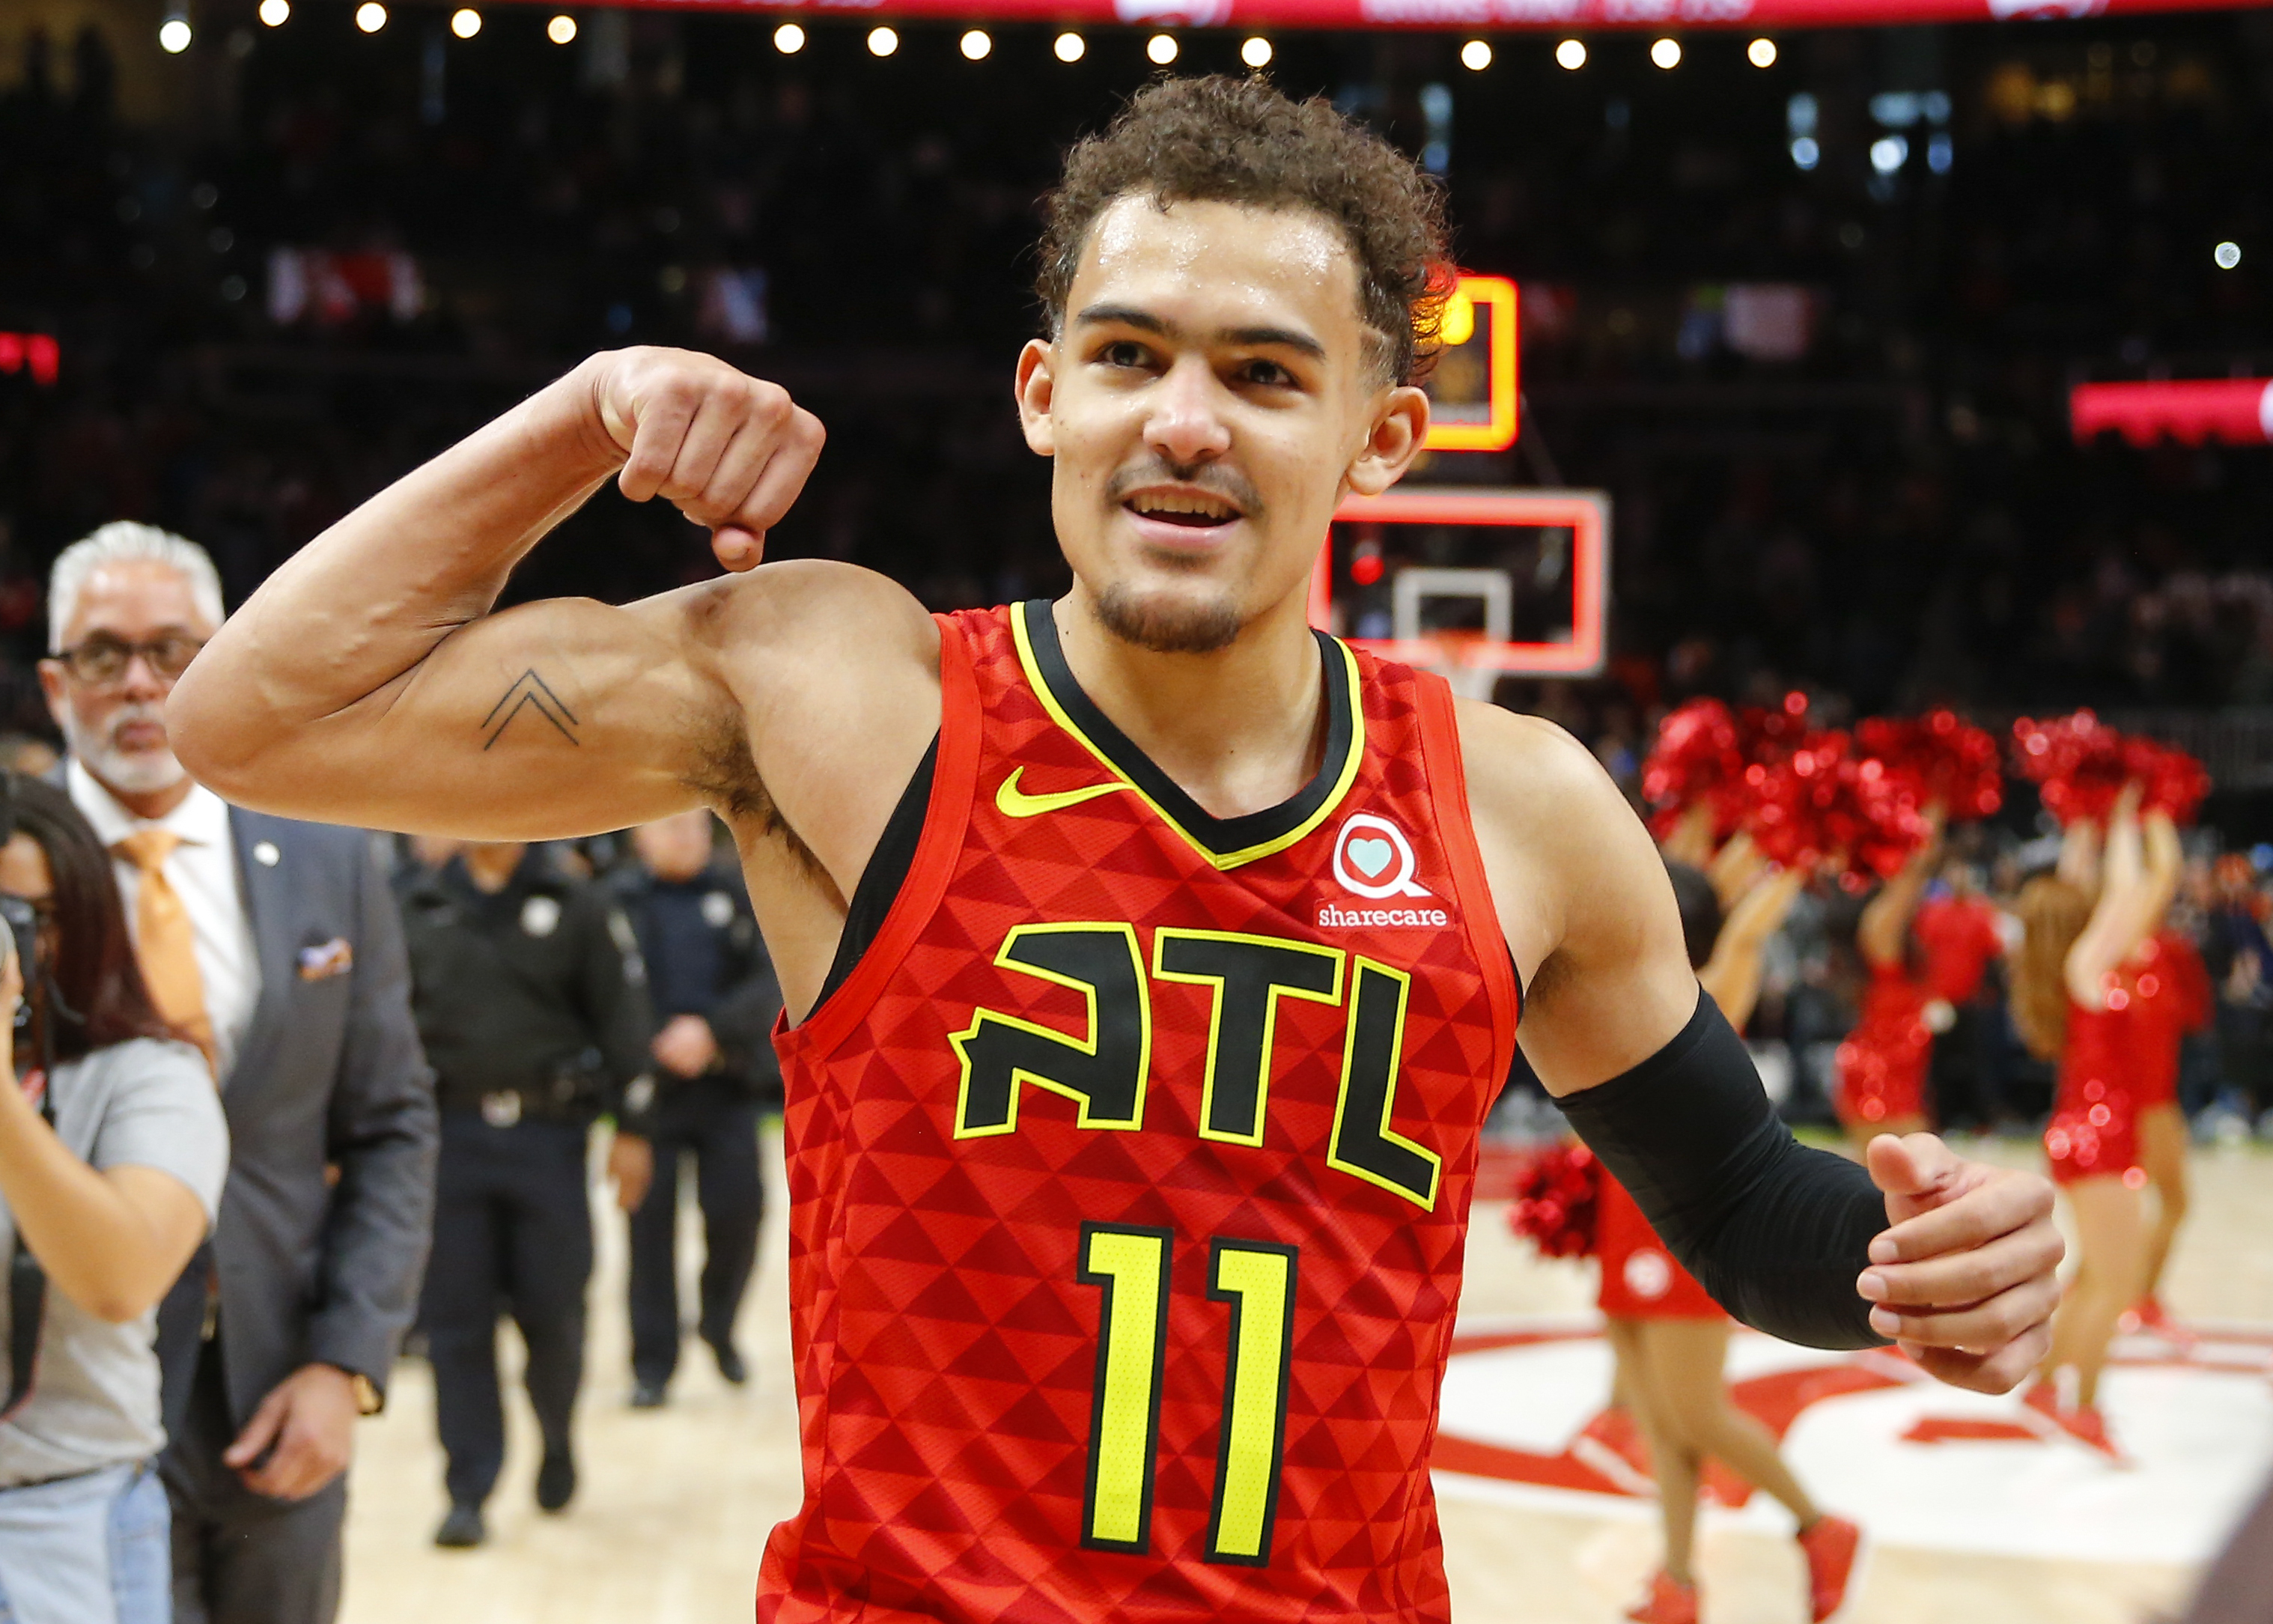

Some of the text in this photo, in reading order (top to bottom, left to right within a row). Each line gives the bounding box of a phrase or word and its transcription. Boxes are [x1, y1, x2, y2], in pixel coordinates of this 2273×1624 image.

[1318, 904, 1447, 927] sharecare
[947, 921, 1442, 1213] ATL
[1076, 1220, 1298, 1567] 11
